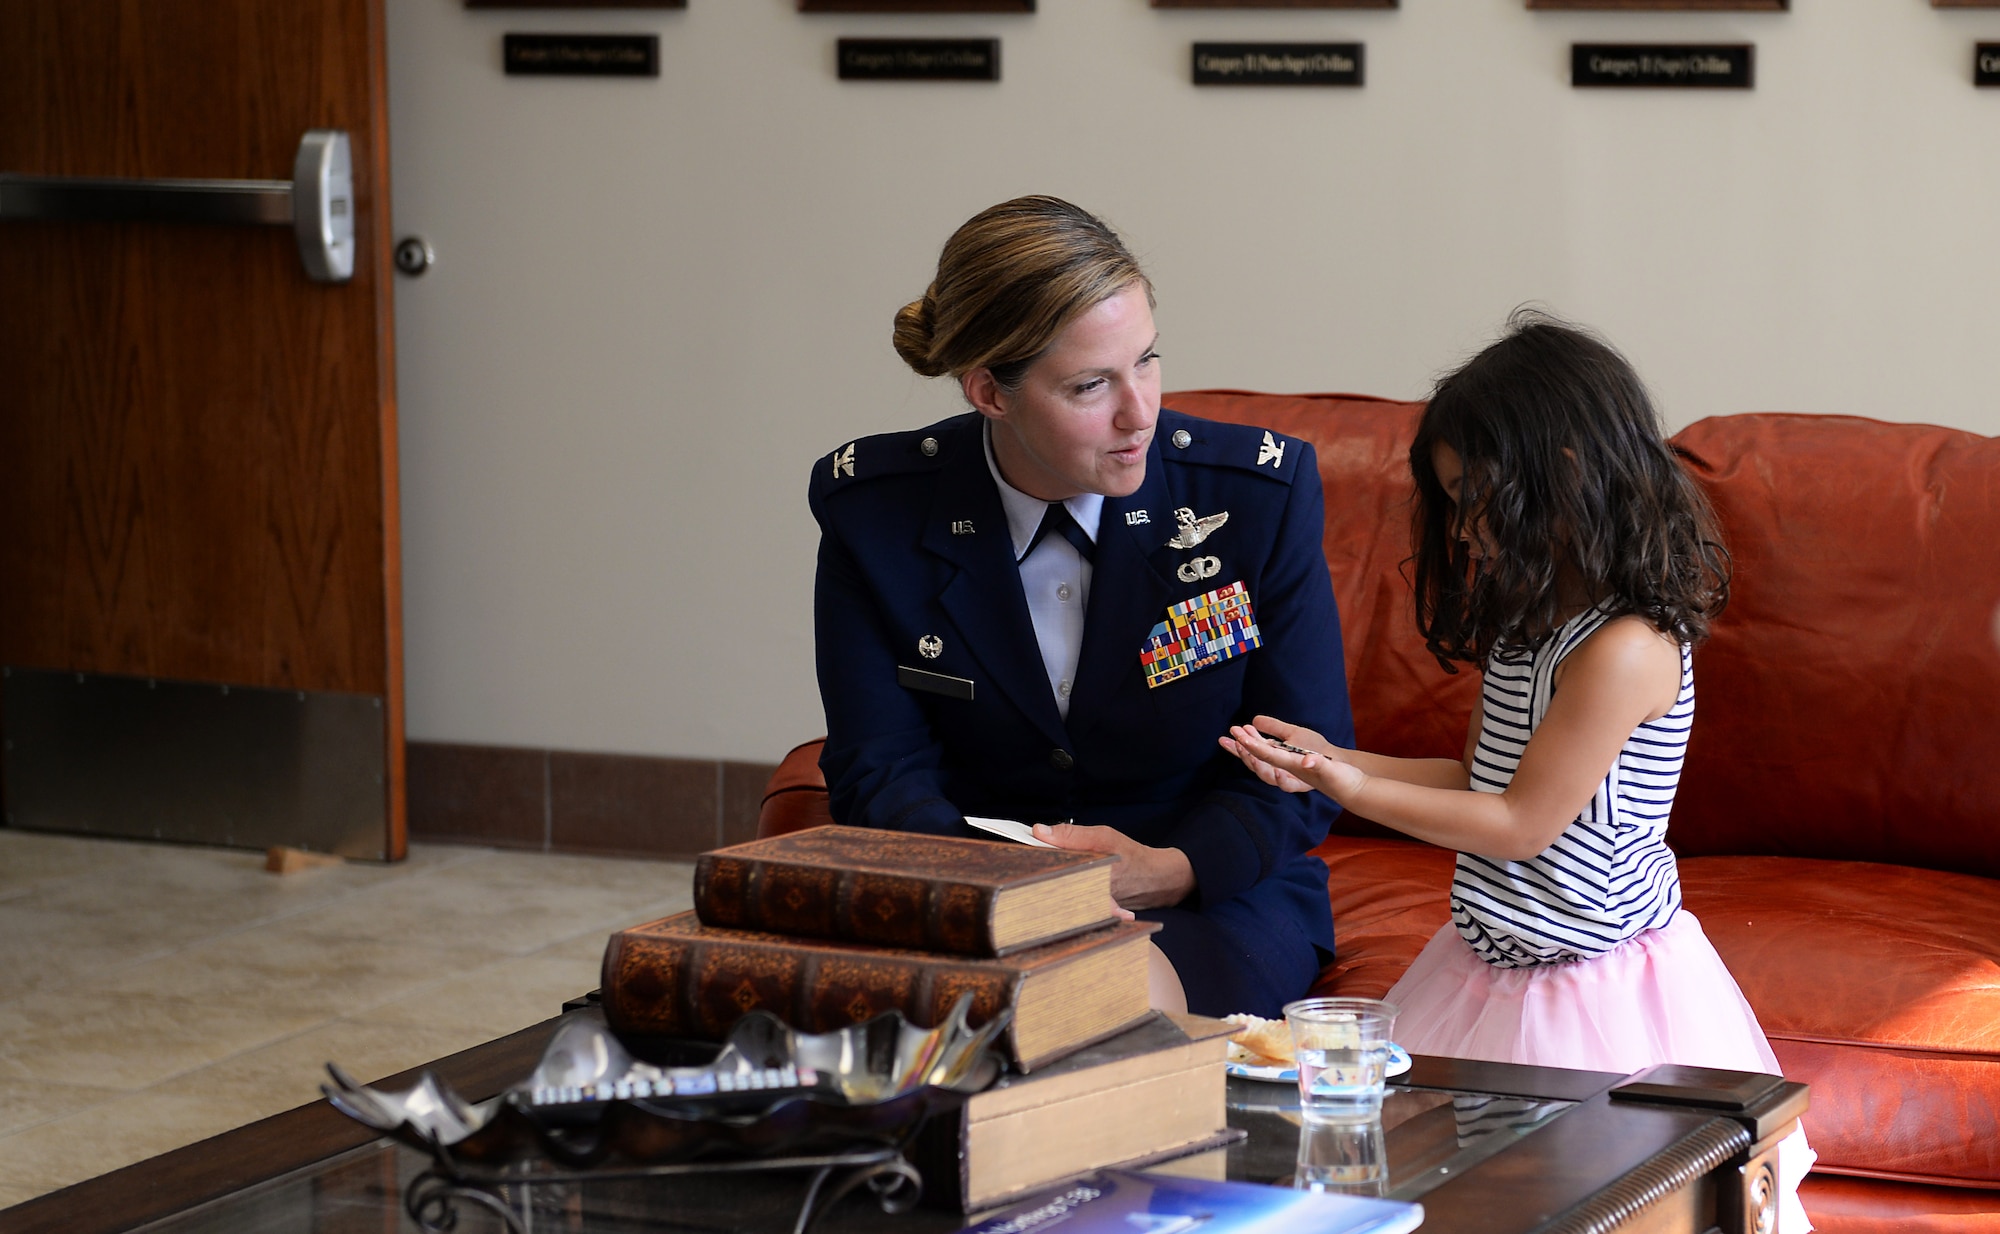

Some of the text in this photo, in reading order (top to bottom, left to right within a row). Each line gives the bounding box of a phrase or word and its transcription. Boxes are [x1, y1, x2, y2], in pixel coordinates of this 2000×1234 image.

[1197, 53, 1243, 76] Category
[1313, 53, 1354, 72] Civilian
[1589, 54, 1638, 78] Category
[1688, 54, 1732, 74] Civilian
